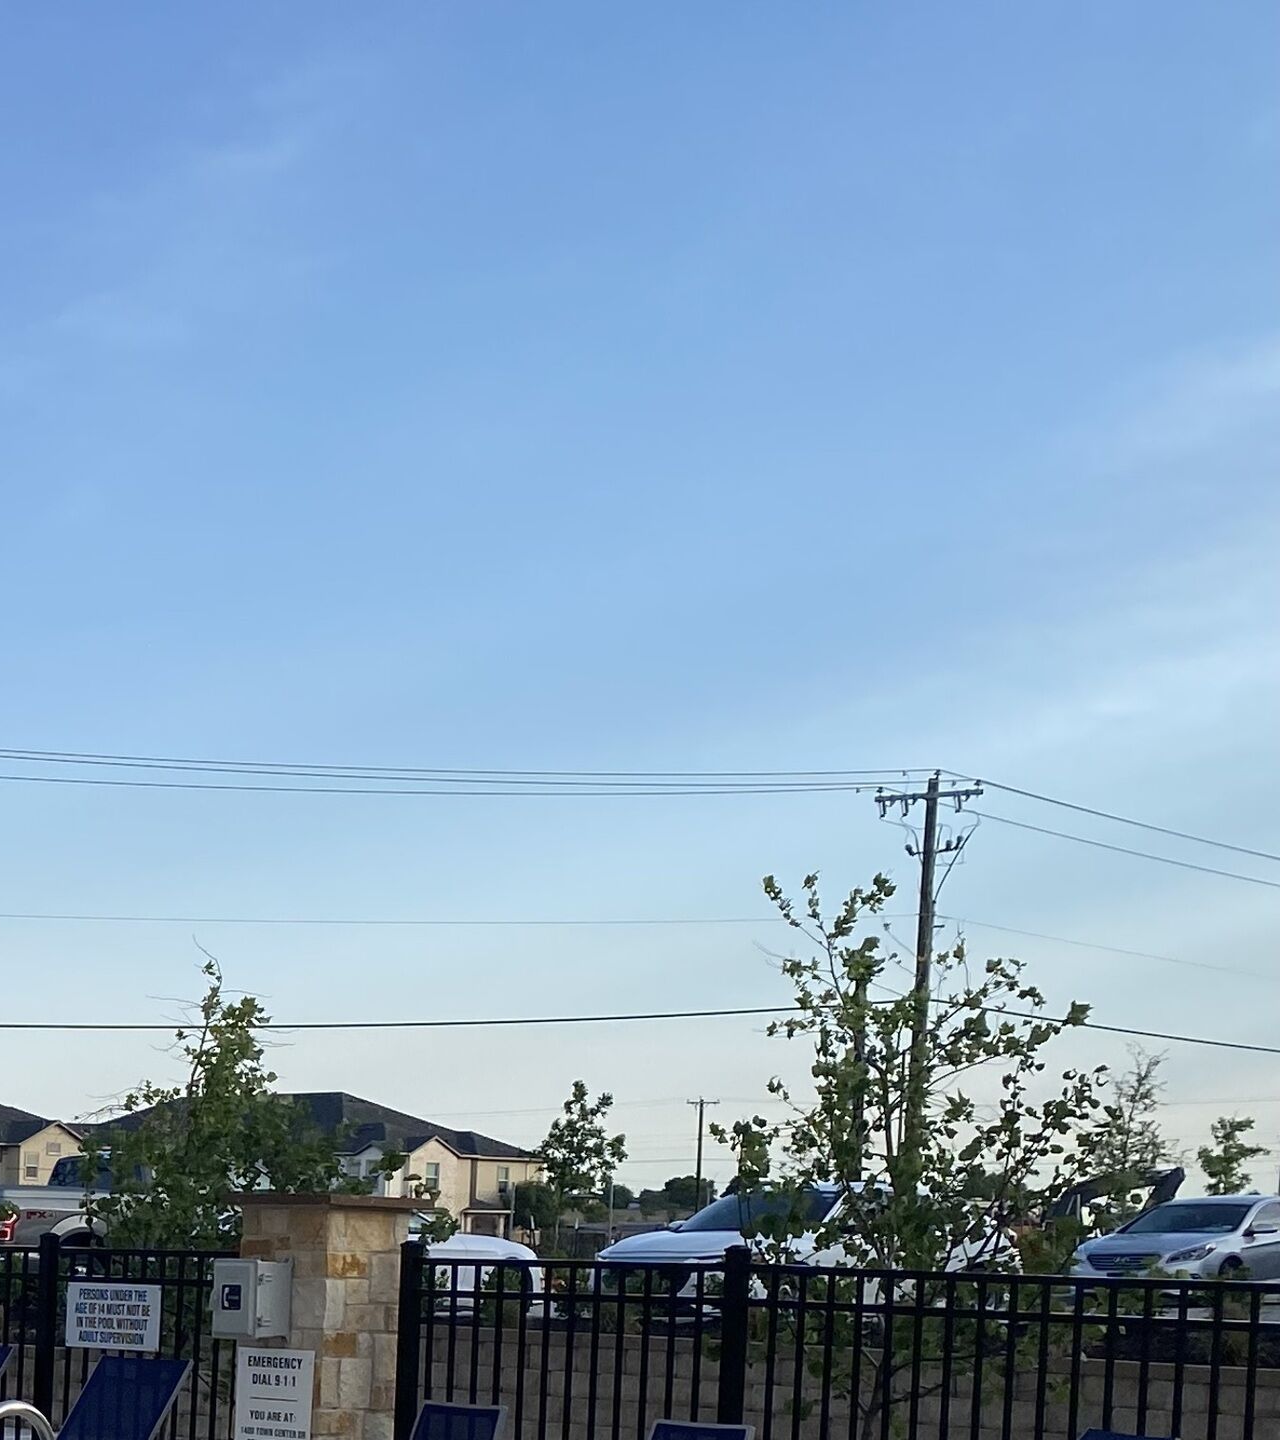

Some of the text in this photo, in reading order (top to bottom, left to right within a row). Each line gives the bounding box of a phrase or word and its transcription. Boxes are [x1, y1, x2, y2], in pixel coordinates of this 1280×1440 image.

[79, 1288, 147, 1302] PERSONS UNDER THE
[75, 1302, 151, 1317] AGE OF 14 MUST NOT BE
[76, 1316, 148, 1331] IN THE POOL WITHOUT
[78, 1330, 145, 1345] ADULT SUPERVISION
[247, 1355, 303, 1370] EMERGENCY
[252, 1373, 272, 1386] DIAL
[249, 1409, 265, 1420] YOU
[266, 1411, 281, 1422] ARE
[274, 1428, 297, 1439] CENTER
